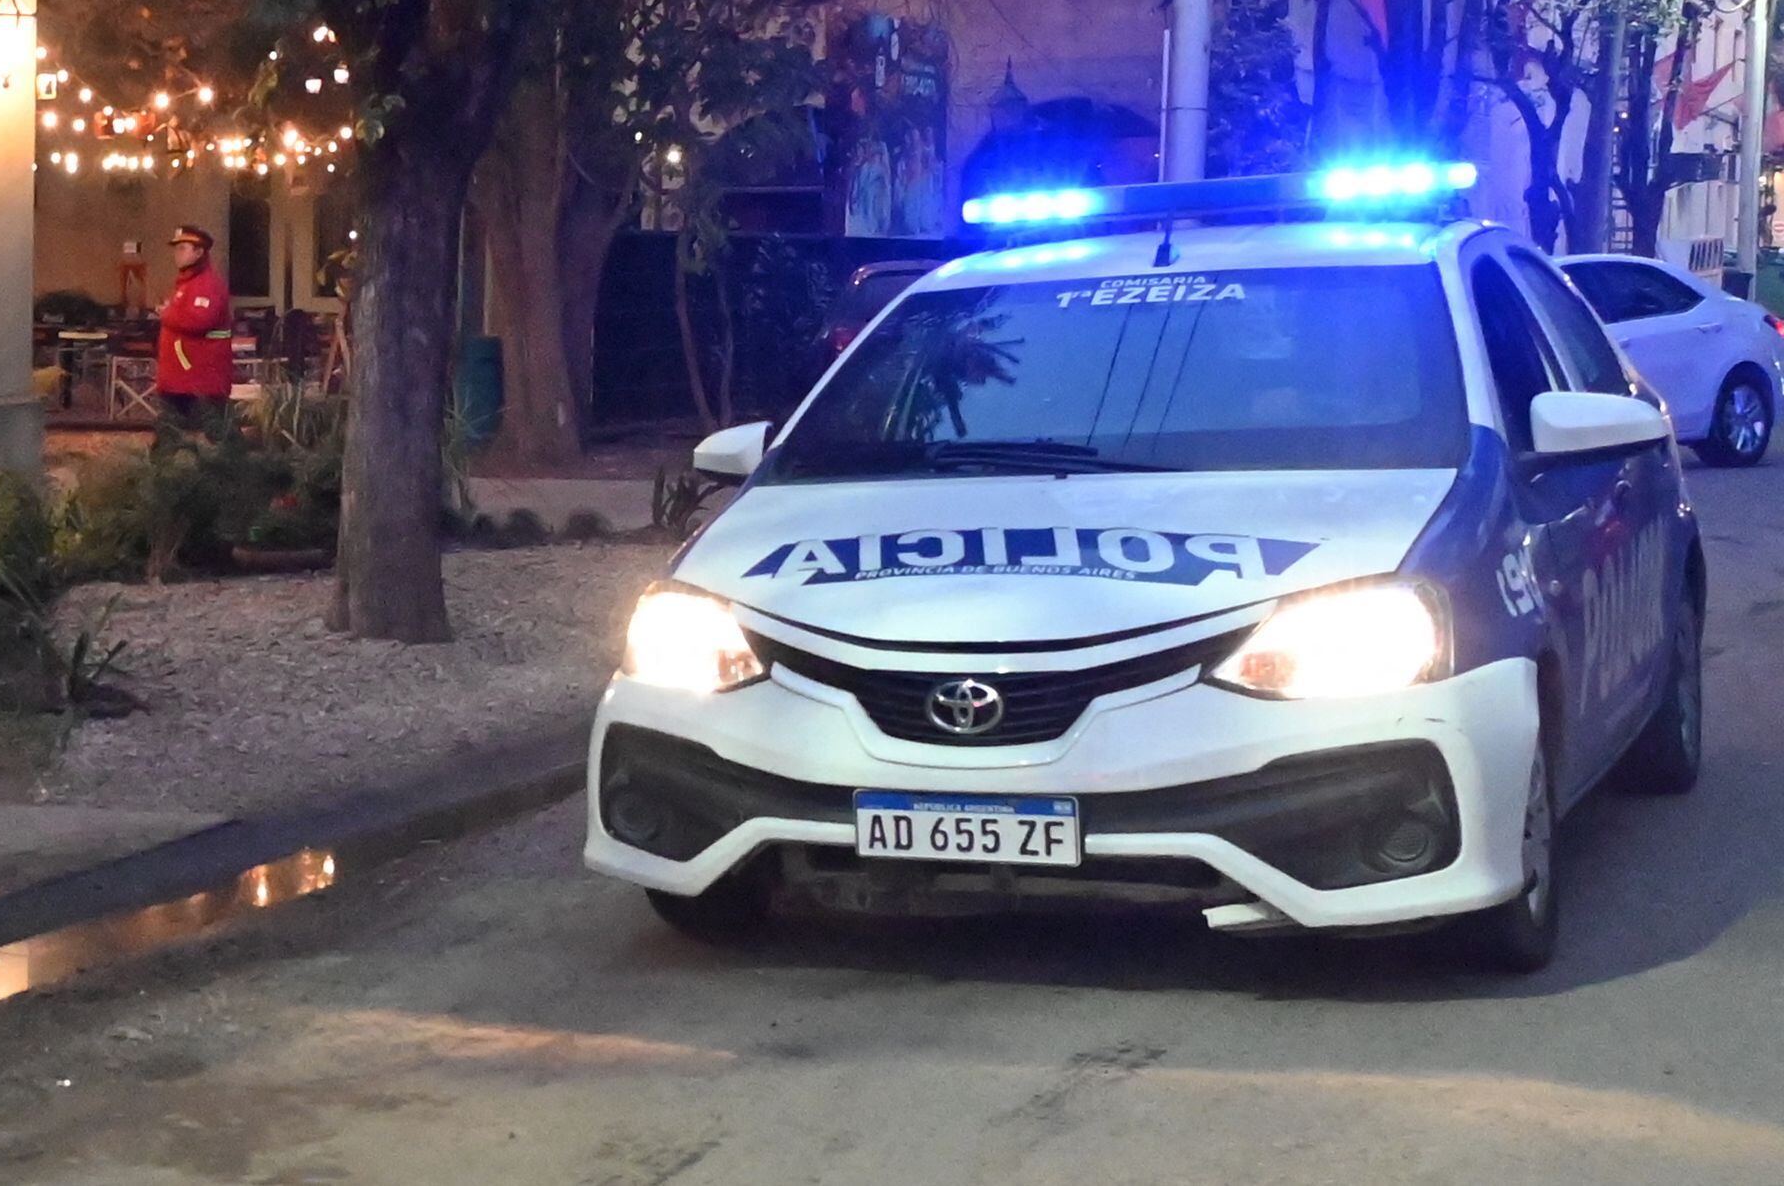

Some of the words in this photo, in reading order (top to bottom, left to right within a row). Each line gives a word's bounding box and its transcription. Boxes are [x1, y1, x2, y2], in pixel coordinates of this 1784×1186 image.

[1100, 276, 1206, 288] COMISARIA
[1090, 283, 1246, 306] EZEIZA
[854, 565, 955, 581] PROVINCIA
[964, 564, 988, 575] DE
[992, 564, 1068, 575] BUENOS
[1078, 565, 1137, 580] AIRES
[868, 815, 914, 851] AD
[929, 817, 1001, 854] 655
[1016, 819, 1065, 857] ZF
